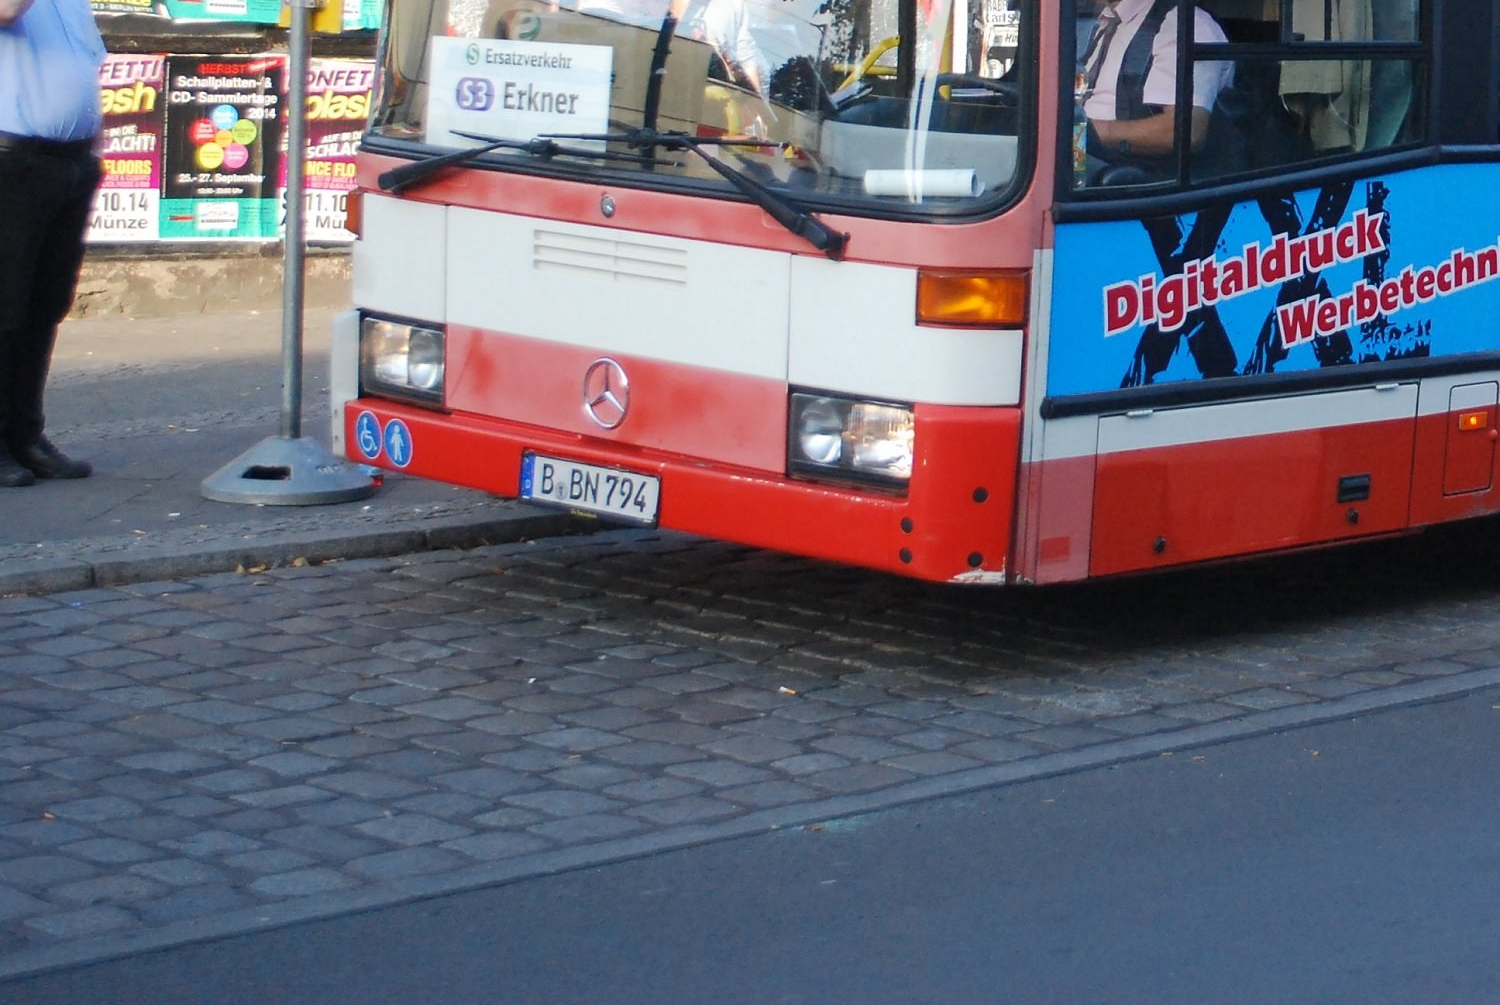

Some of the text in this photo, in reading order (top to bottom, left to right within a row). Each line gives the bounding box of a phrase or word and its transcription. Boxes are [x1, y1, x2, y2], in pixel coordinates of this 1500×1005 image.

[486, 48, 572, 69] Ersatzverkehr
[99, 60, 162, 80] FETTI
[307, 70, 373, 87] ONFET
[177, 76, 261, 90] Schallplatten-
[101, 82, 157, 113] ash
[461, 80, 579, 115] S3 Erkner
[248, 108, 276, 119] 2014
[104, 133, 157, 152] ACHT!
[306, 142, 359, 159] SCHLAC
[305, 161, 356, 177] NCE FLO
[95, 192, 148, 213] .10.14
[307, 193, 347, 213] 11.10
[90, 213, 148, 229] Münze
[1104, 208, 1385, 338] Digitaldruck
[541, 463, 647, 512] B BN 794
